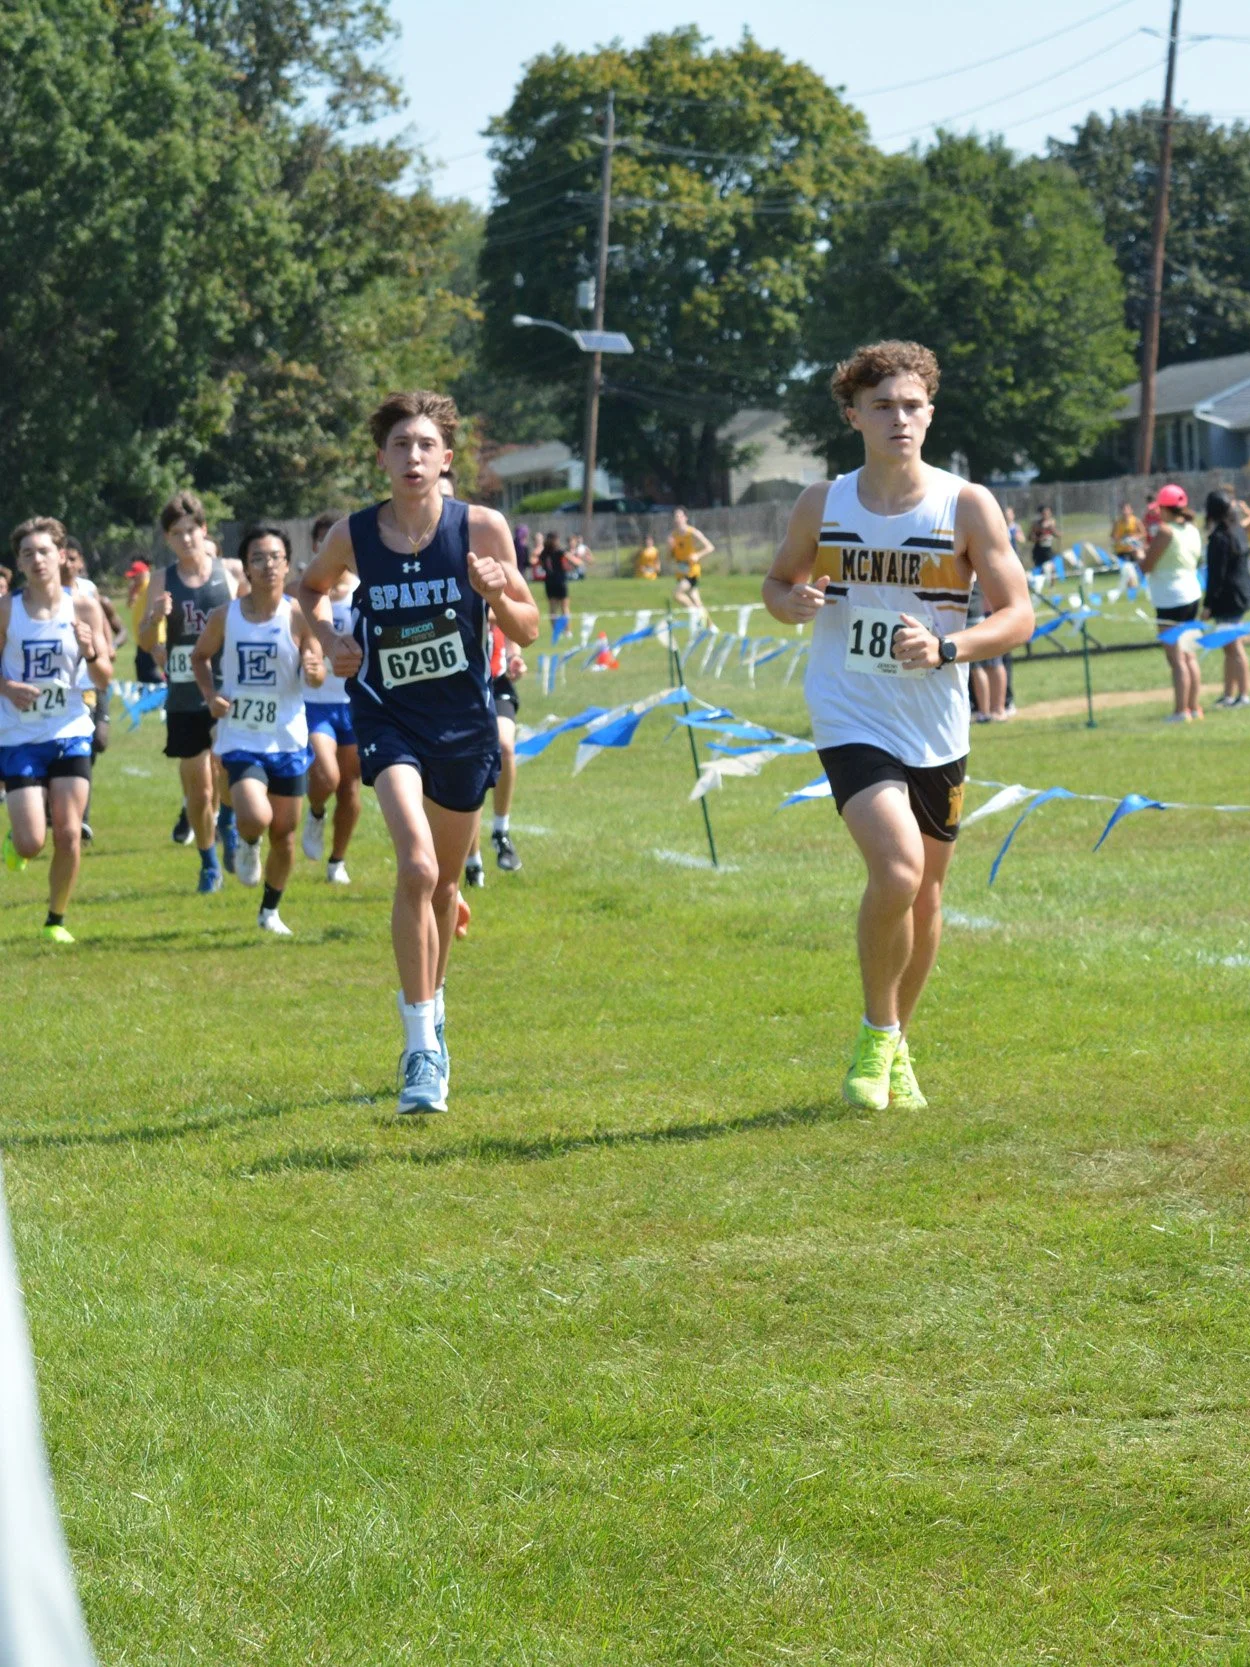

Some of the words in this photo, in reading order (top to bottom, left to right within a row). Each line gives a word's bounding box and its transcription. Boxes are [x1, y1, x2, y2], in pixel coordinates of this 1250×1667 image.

[842, 548, 921, 585] MCNAIR
[369, 577, 462, 611] SPARTA
[850, 618, 914, 660] 18
[22, 639, 62, 682] E
[171, 652, 193, 673] 18
[236, 641, 277, 686] E
[387, 641, 457, 680] 6296
[22, 687, 66, 713] 24
[231, 698, 277, 724] 1738
